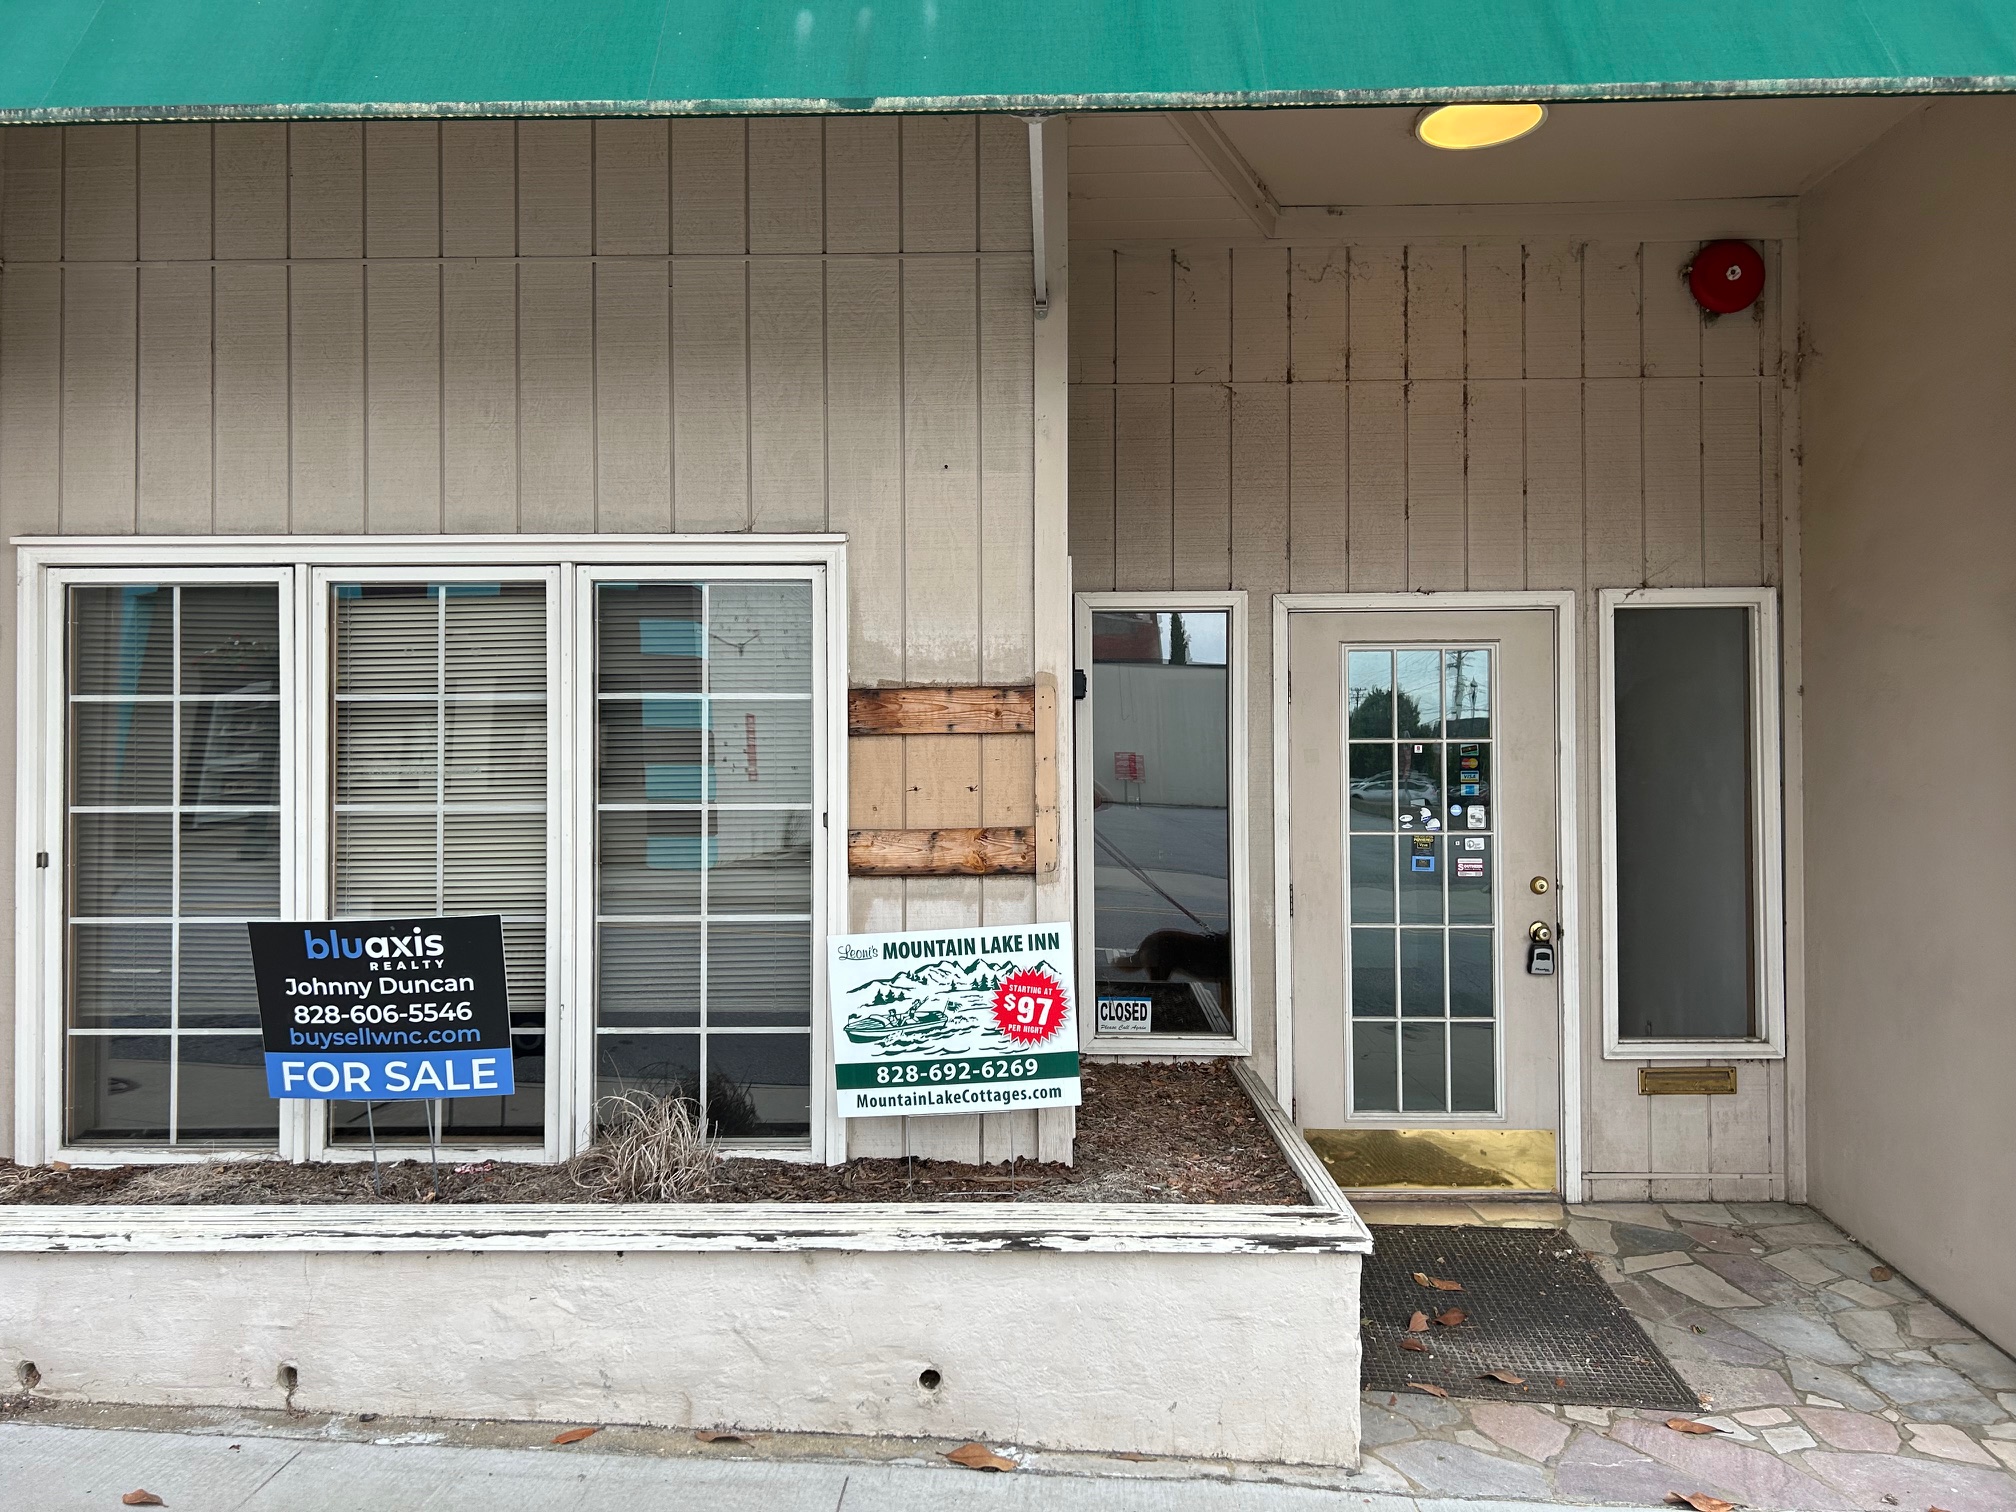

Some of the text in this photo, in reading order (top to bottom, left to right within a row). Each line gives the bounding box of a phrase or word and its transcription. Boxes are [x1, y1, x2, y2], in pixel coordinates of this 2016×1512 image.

[304, 926, 444, 959] bluaxis
[837, 932, 1060, 961] Leoni's MOUNTAIN LAKE INN
[369, 959, 445, 971] REALTY
[285, 976, 475, 999] Johnny Duncan
[1008, 983, 1053, 996] STARTING AT
[293, 1001, 473, 1025] 828-606-5546
[1003, 996, 1054, 1026] $97
[1100, 1002, 1147, 1021] CLOSED
[289, 1027, 481, 1049] buysellwnc.com
[1008, 1023, 1044, 1035] PER NIGHT
[281, 1057, 498, 1092] FOR SALE
[876, 1058, 1039, 1084] 828-692-6269
[856, 1085, 1062, 1109] MountainLakeCottages.com
